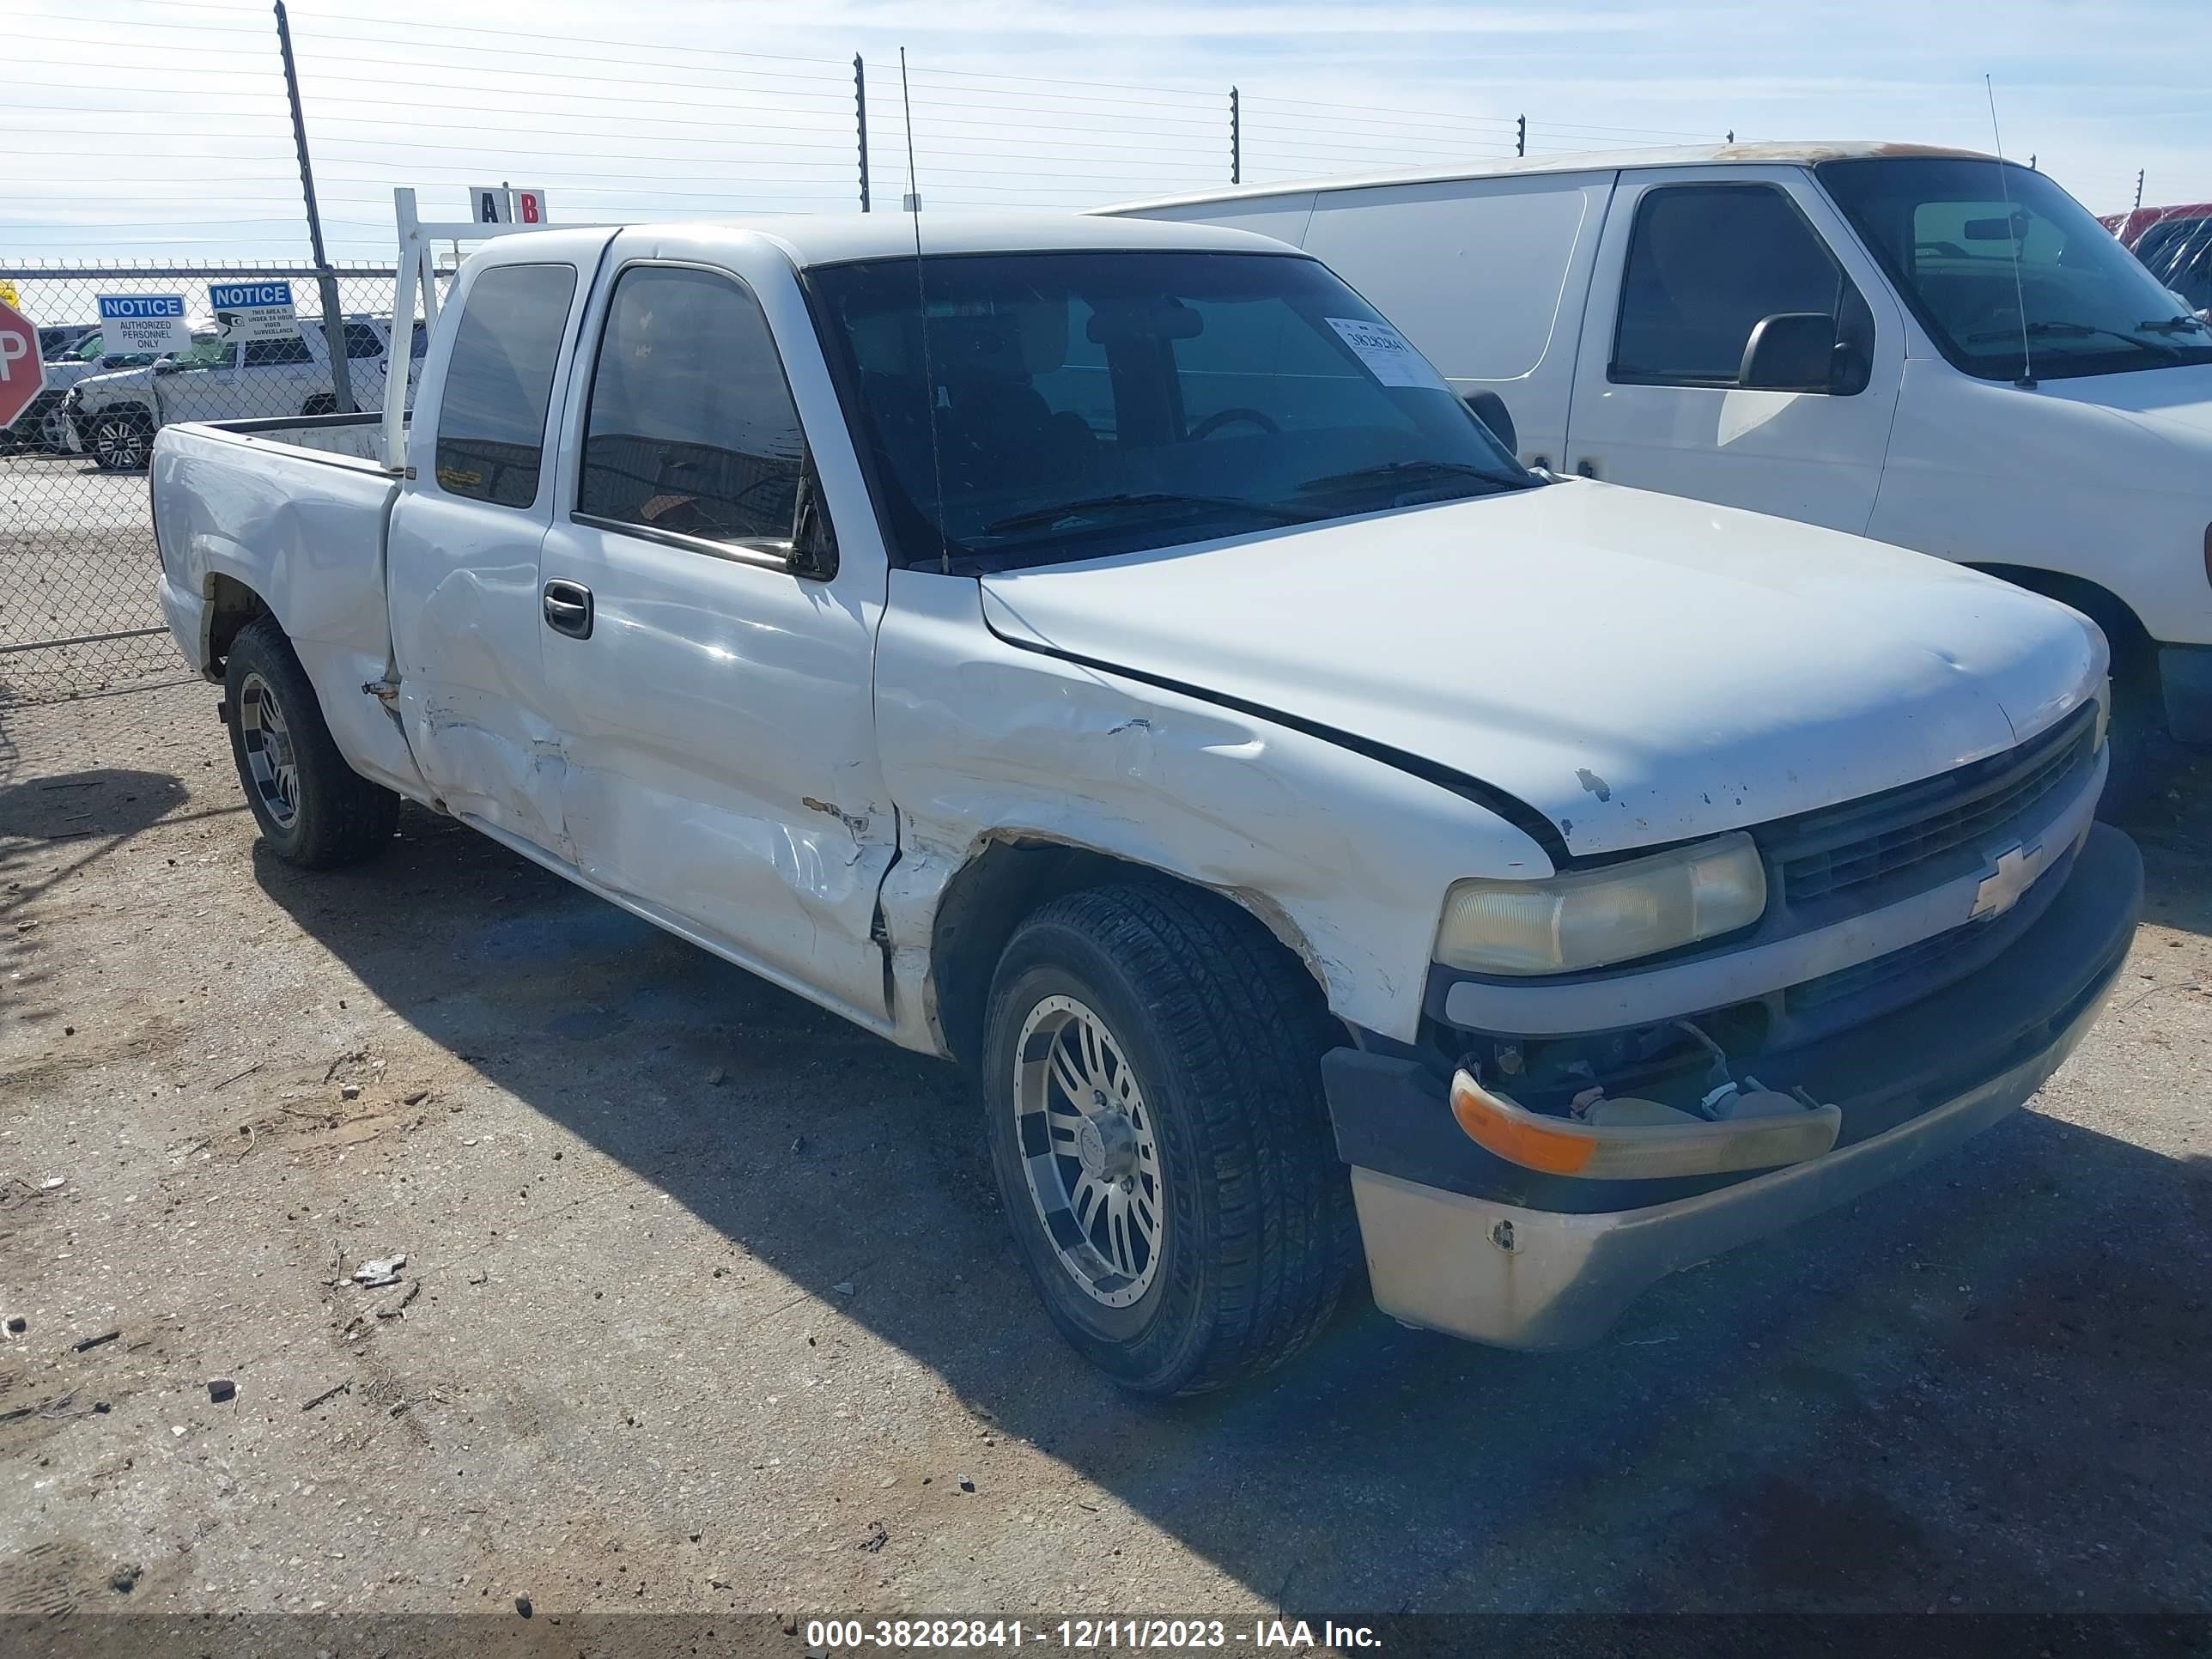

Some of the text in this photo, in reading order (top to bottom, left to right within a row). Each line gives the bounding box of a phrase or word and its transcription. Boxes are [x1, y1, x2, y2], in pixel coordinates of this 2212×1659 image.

[482, 193, 498, 223] A
[521, 194, 538, 223] B
[216, 286, 286, 305] NOTICE
[104, 300, 179, 315] NOTICE
[120, 320, 171, 330] AUTHORIZED
[253, 327, 294, 336] SURVEILLANCE
[123, 330, 172, 339] PERSONNEL
[137, 339, 159, 349] ONLY
[1347, 333, 1408, 353] 38282841
